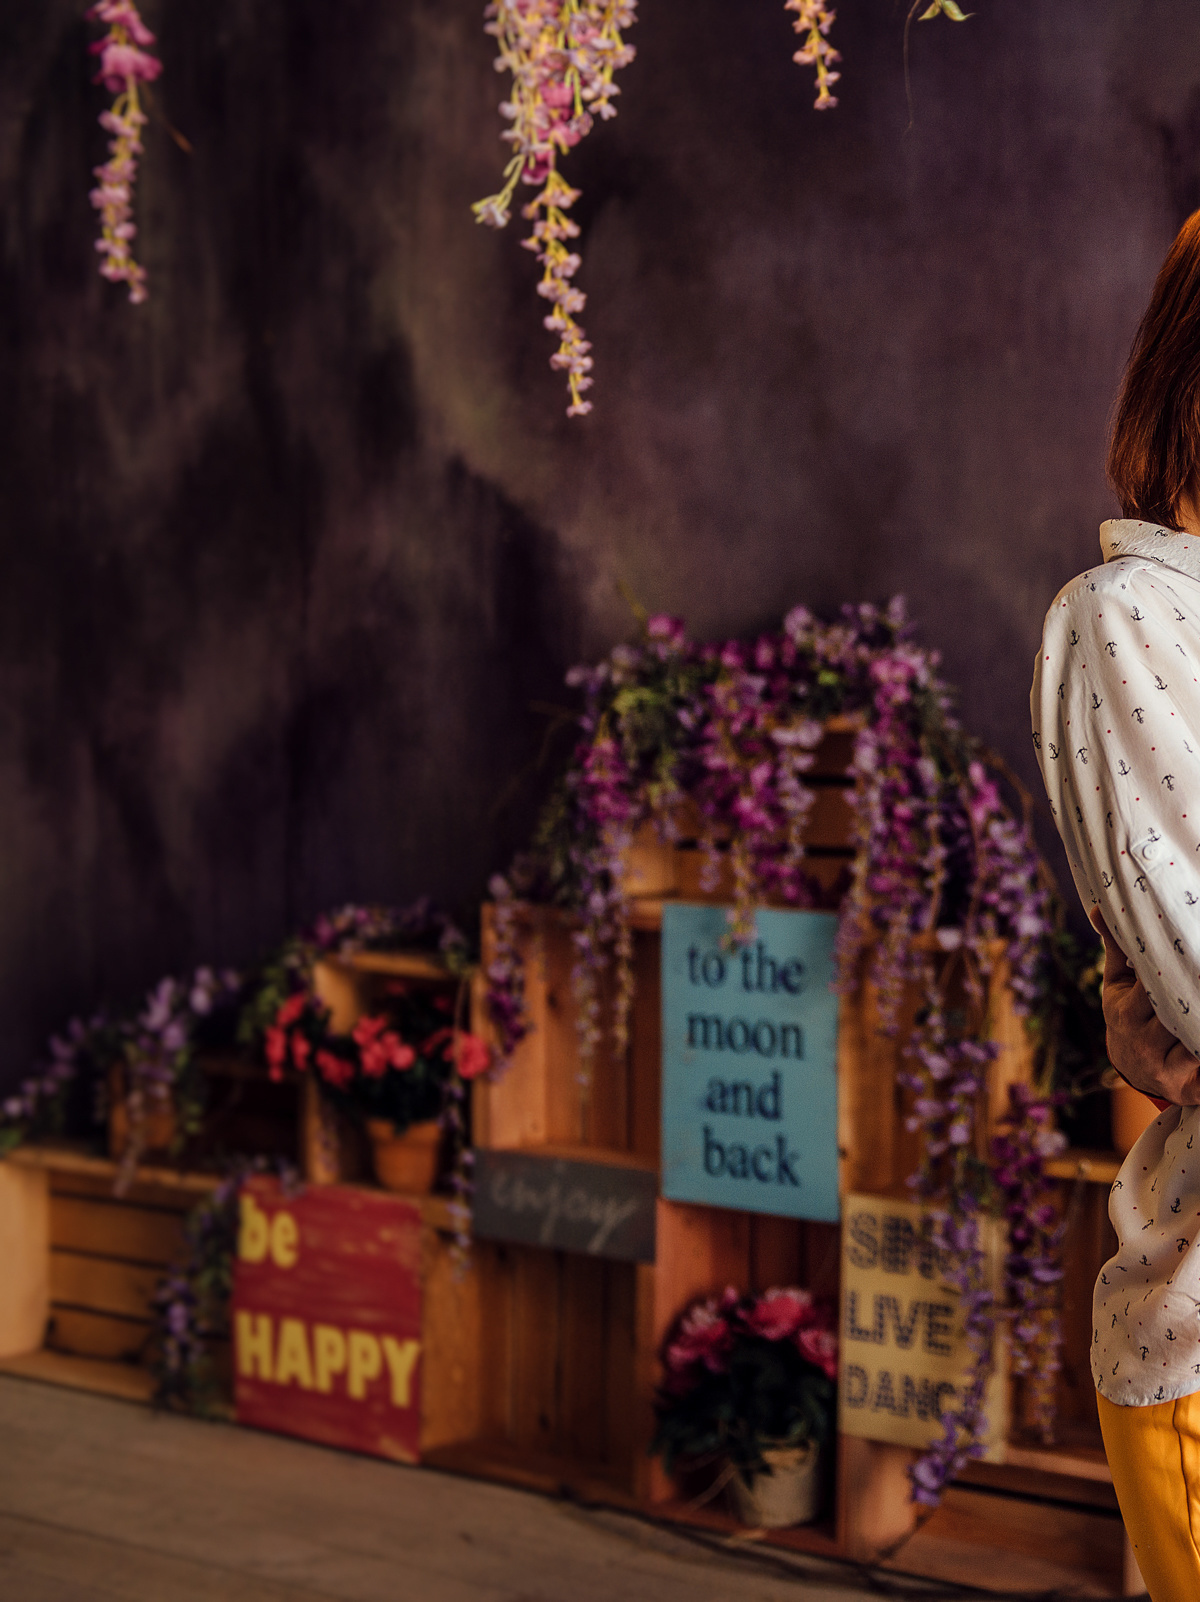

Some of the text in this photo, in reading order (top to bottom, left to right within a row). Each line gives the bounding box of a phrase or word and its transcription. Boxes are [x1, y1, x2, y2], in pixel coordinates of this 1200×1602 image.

[688, 937, 805, 996] to the
[686, 1012, 804, 1061] moon
[704, 1069, 783, 1122] and
[702, 1124, 800, 1188] back
[238, 1194, 298, 1269] be
[848, 1211, 964, 1281] SIN
[845, 1290, 955, 1358] LIVE
[235, 1310, 421, 1409] HAPPY
[845, 1363, 982, 1424] DANC
